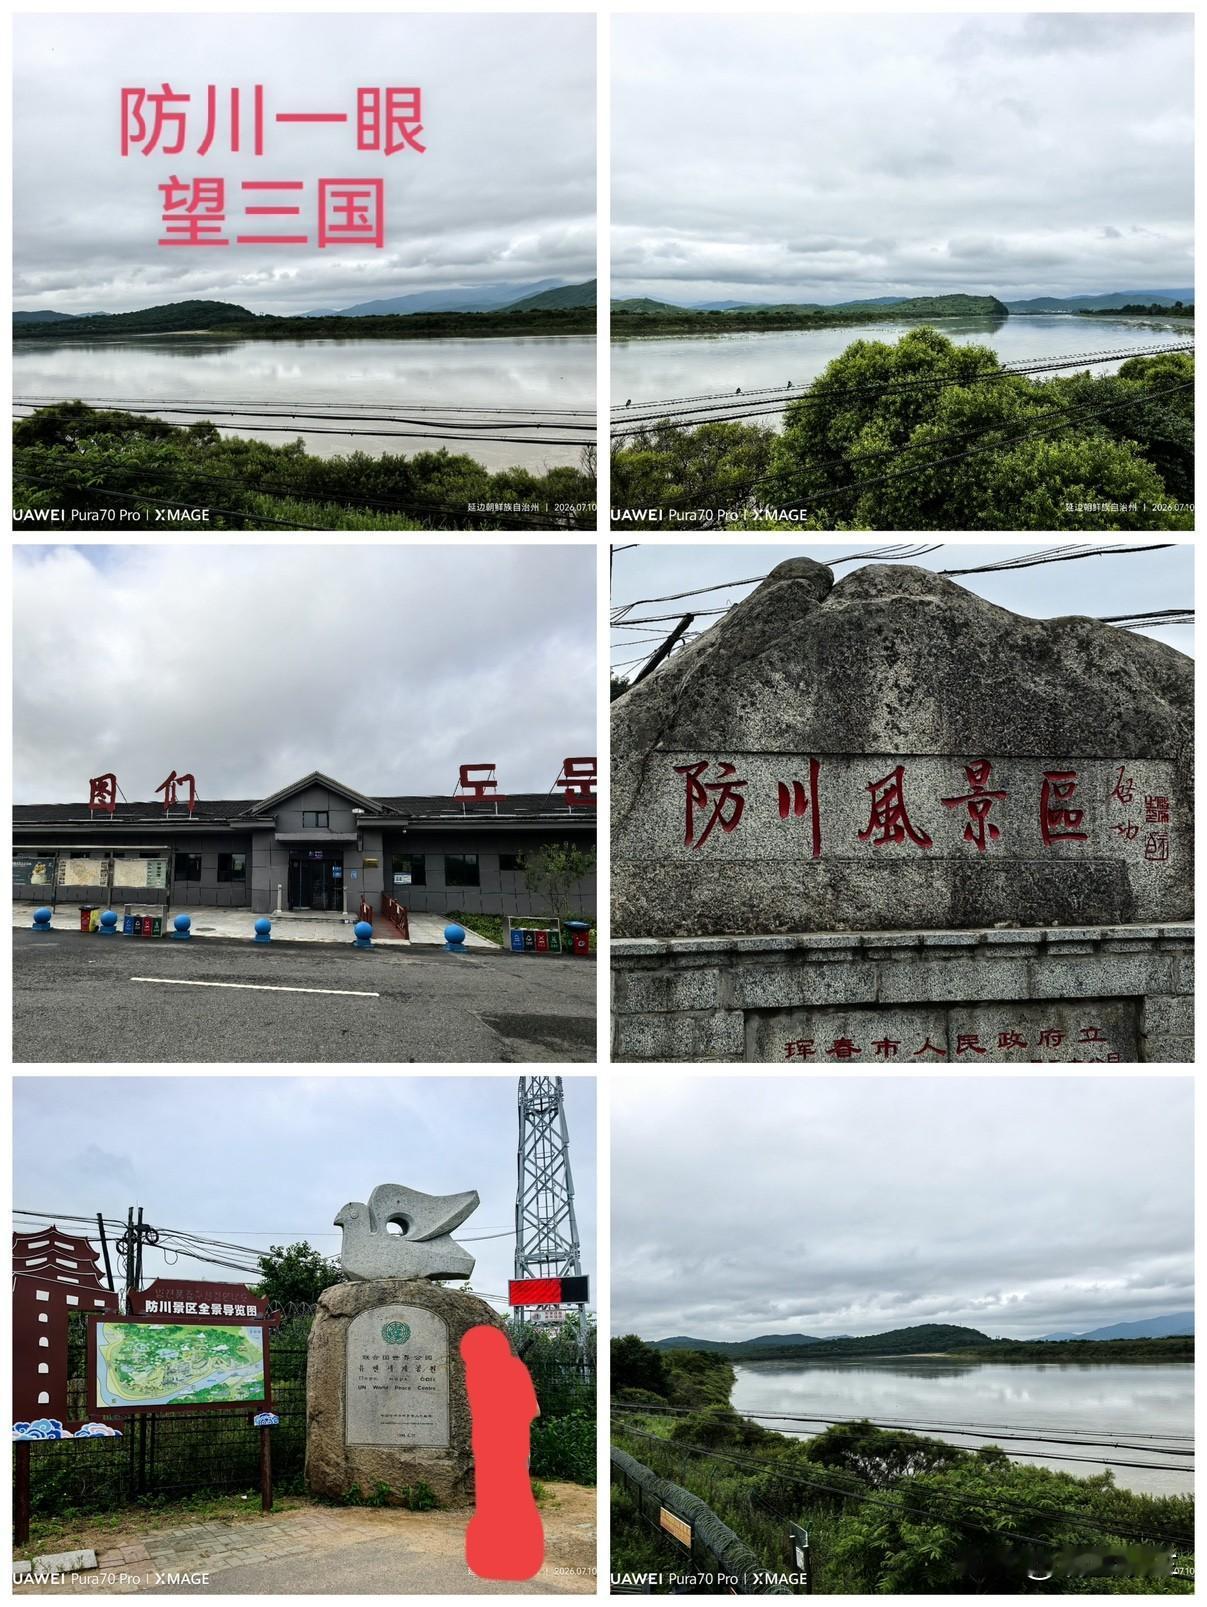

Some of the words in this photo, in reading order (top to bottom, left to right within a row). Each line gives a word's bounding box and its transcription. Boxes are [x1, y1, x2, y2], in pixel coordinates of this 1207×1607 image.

[88, 770, 196, 812] 图们
[673, 757, 1089, 857] 防川風景區
[784, 1026, 1107, 1060] 珲春市人民政府立
[145, 1300, 257, 1317] 防川景区全景导览图
